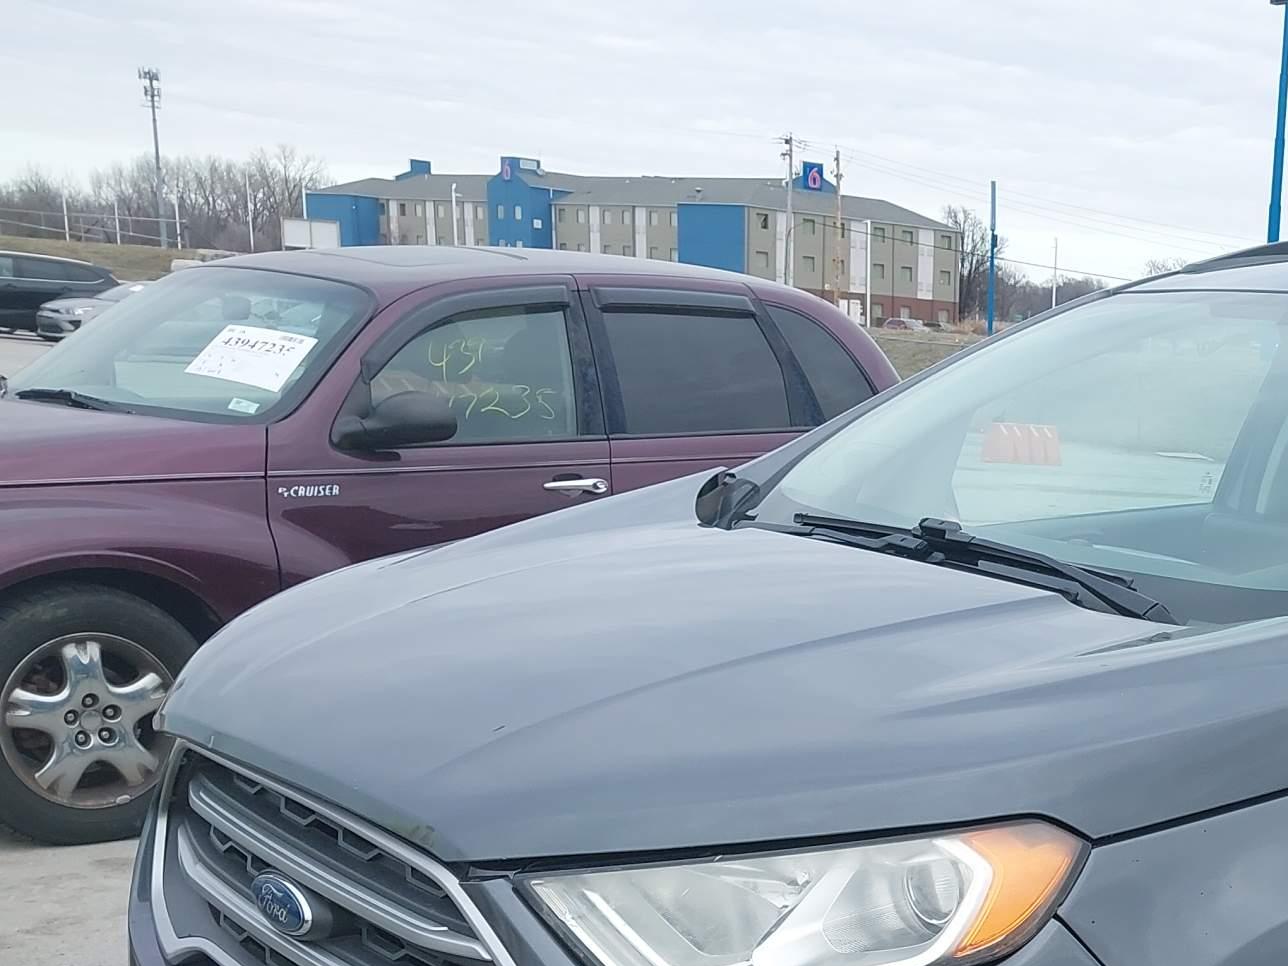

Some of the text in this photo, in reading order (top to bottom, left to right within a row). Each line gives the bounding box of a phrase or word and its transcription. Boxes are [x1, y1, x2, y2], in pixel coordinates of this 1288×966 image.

[808, 167, 821, 188] 6
[290, 484, 340, 497] CRUISER
[258, 883, 290, 923] Ford
